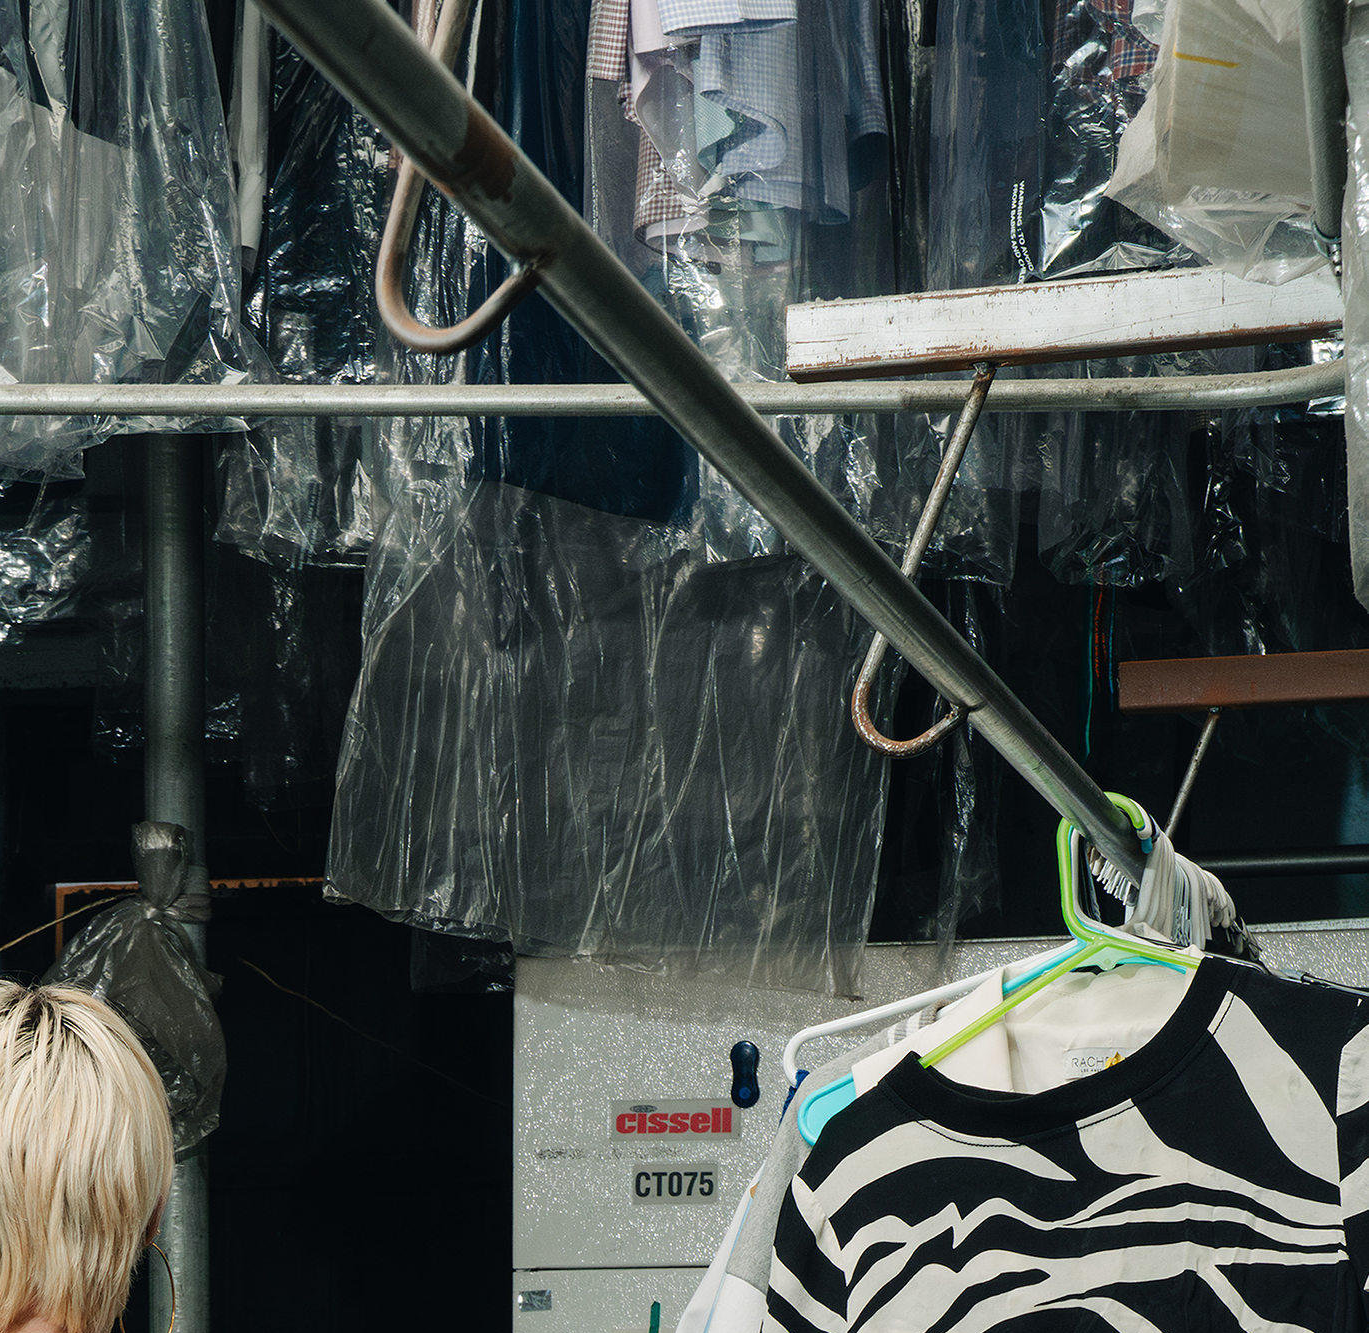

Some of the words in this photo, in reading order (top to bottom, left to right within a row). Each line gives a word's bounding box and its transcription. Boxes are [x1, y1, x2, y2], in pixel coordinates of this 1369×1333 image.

[1016, 180, 1025, 227] WARNING
[1011, 240, 1022, 259] AND
[1018, 232, 1026, 246] TO
[1020, 245, 1035, 272] AVOID
[616, 1107, 732, 1134] cissell
[634, 1171, 714, 1198] CT075
